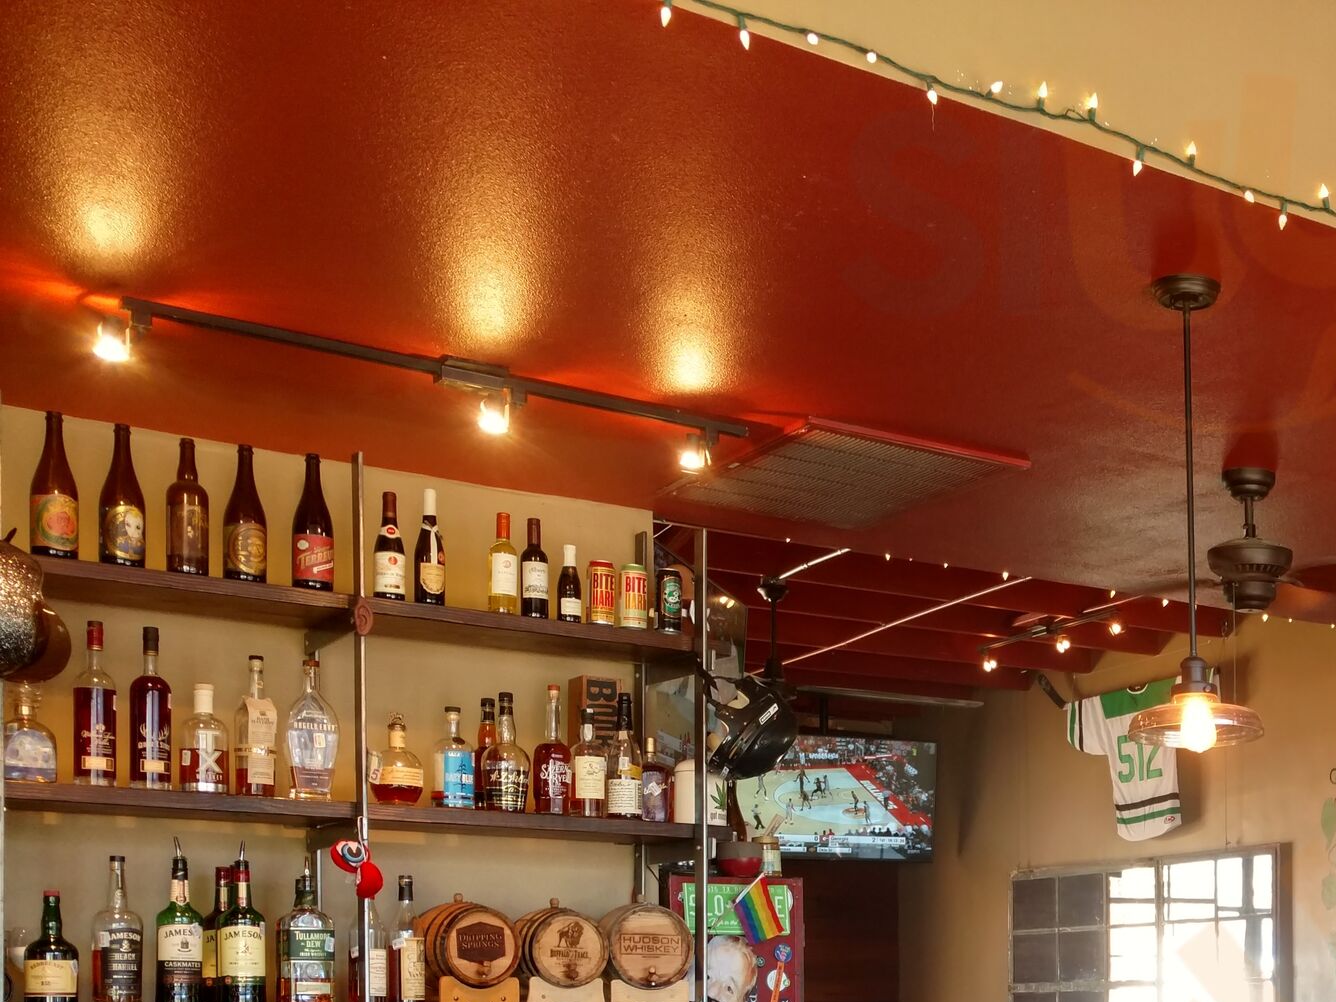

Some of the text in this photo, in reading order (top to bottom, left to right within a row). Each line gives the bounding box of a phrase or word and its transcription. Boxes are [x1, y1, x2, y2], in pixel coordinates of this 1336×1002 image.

[593, 572, 614, 590] BITE
[625, 575, 647, 593] BITE
[1117, 734, 1163, 784] 512
[164, 928, 201, 939] JAMES
[224, 930, 263, 941] JAMESON
[458, 933, 503, 943] DRIPPING
[461, 940, 500, 949] SPRINGS
[622, 935, 680, 945] HUDSON
[623, 944, 680, 953] WHISKEY
